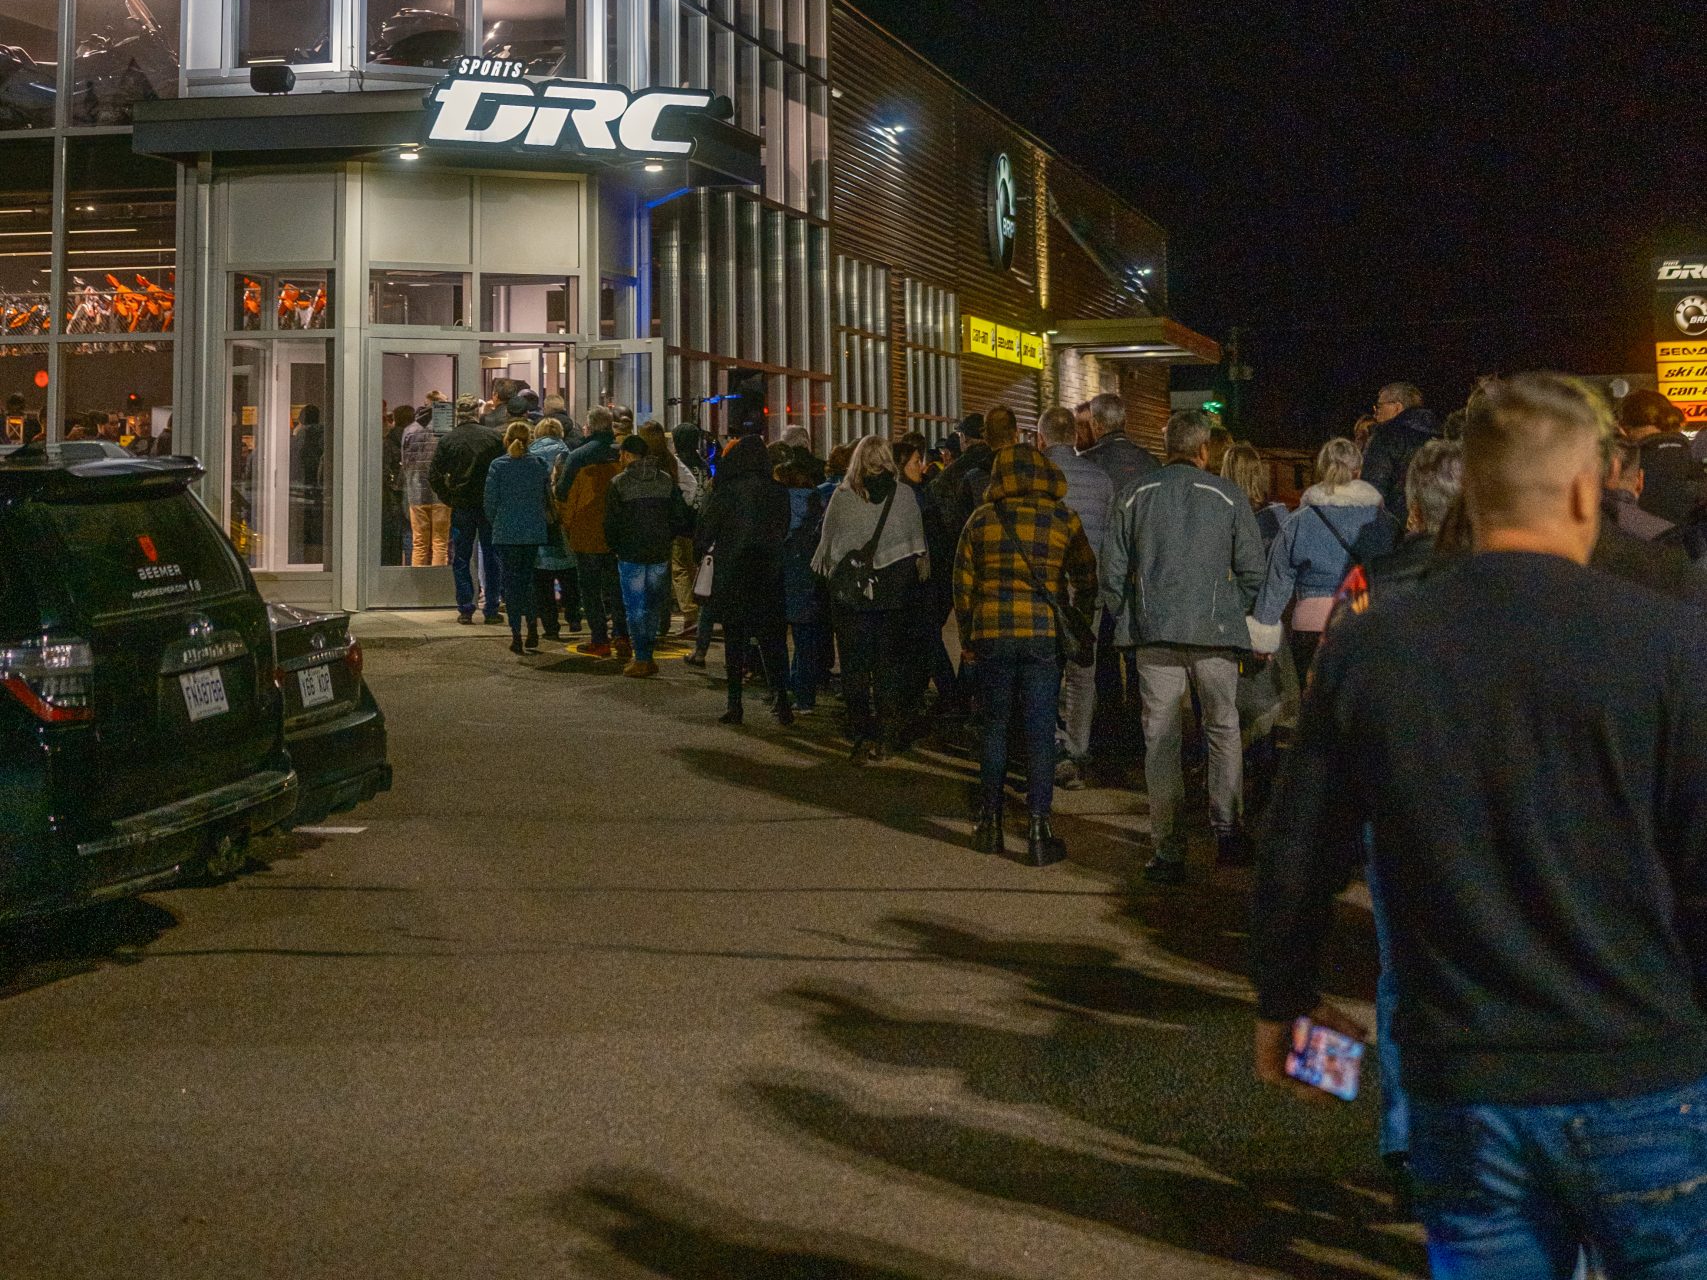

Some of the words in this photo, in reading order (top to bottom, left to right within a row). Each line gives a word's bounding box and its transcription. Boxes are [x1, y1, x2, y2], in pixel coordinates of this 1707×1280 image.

[458, 58, 523, 78] SPORTS
[428, 79, 711, 154] DRC
[137, 564, 182, 580] BEEMER
